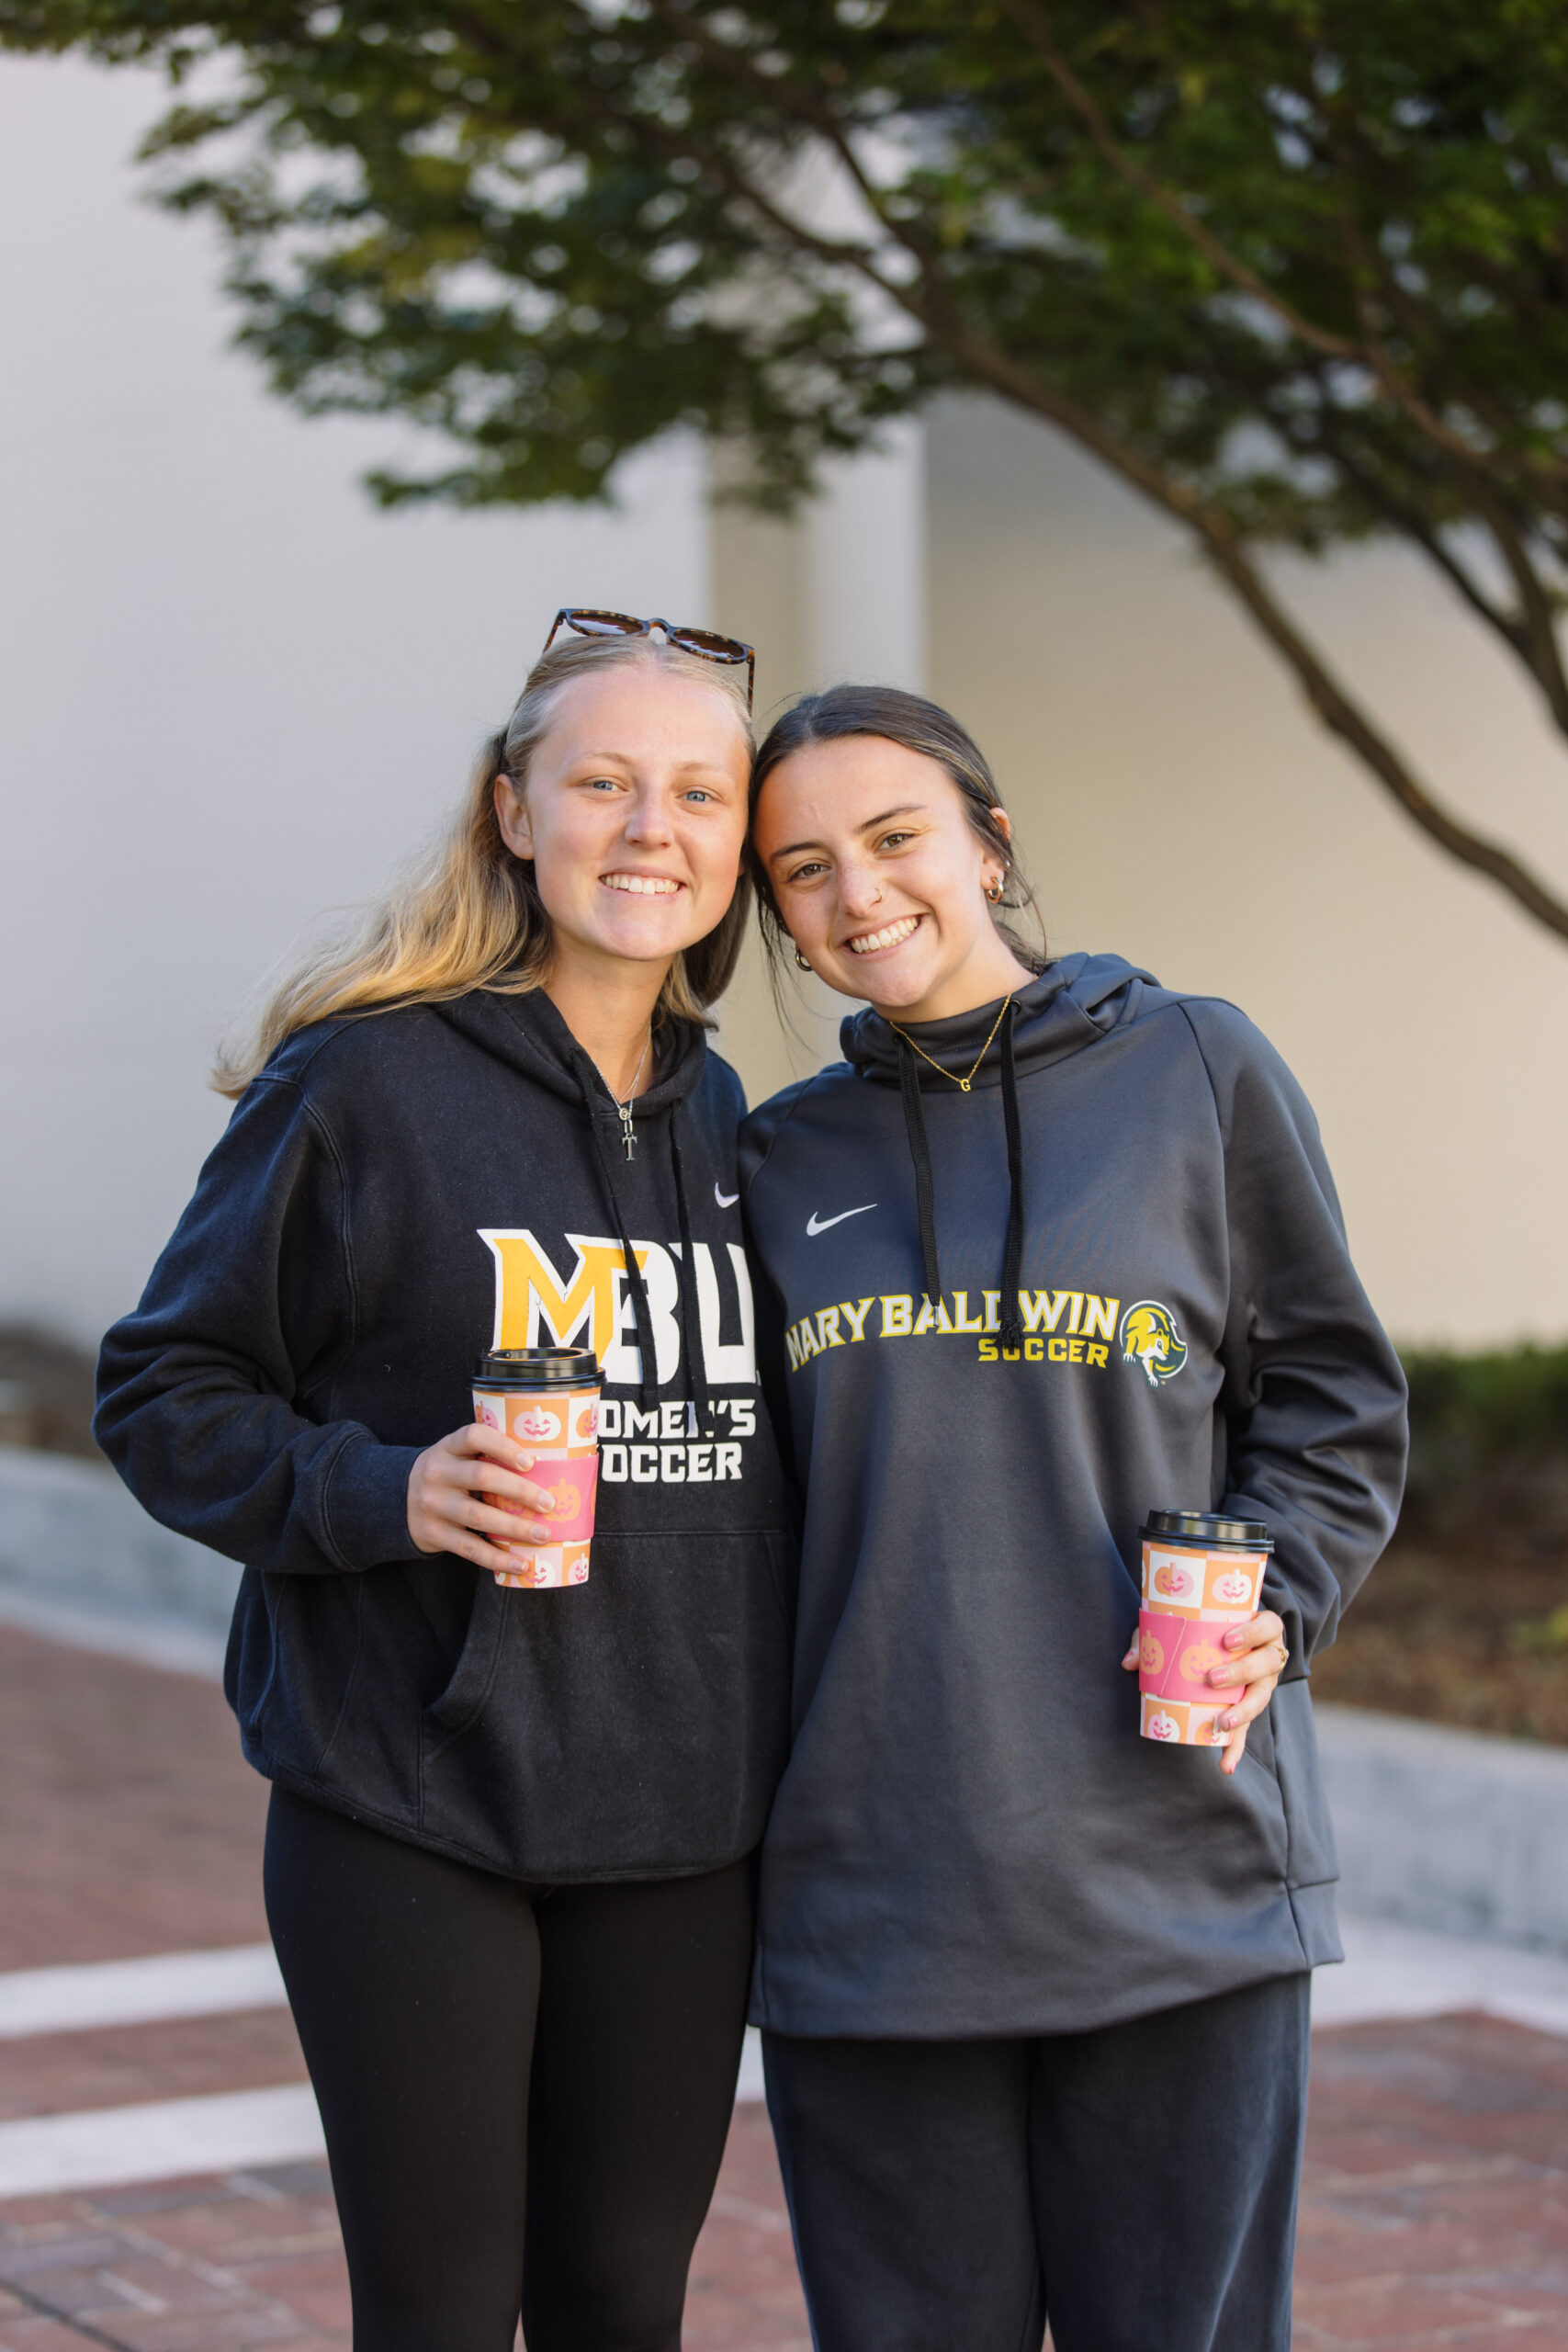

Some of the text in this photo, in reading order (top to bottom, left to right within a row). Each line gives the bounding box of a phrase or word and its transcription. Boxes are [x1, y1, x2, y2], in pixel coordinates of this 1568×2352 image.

[961, 1079, 971, 1091] G
[622, 1135, 637, 1161] T
[476, 1228, 761, 1385] MBU
[785, 1289, 1121, 1373] MARY BALDWIN
[599, 1398, 756, 1439] OME'S
[597, 1442, 743, 1483] OCCER
